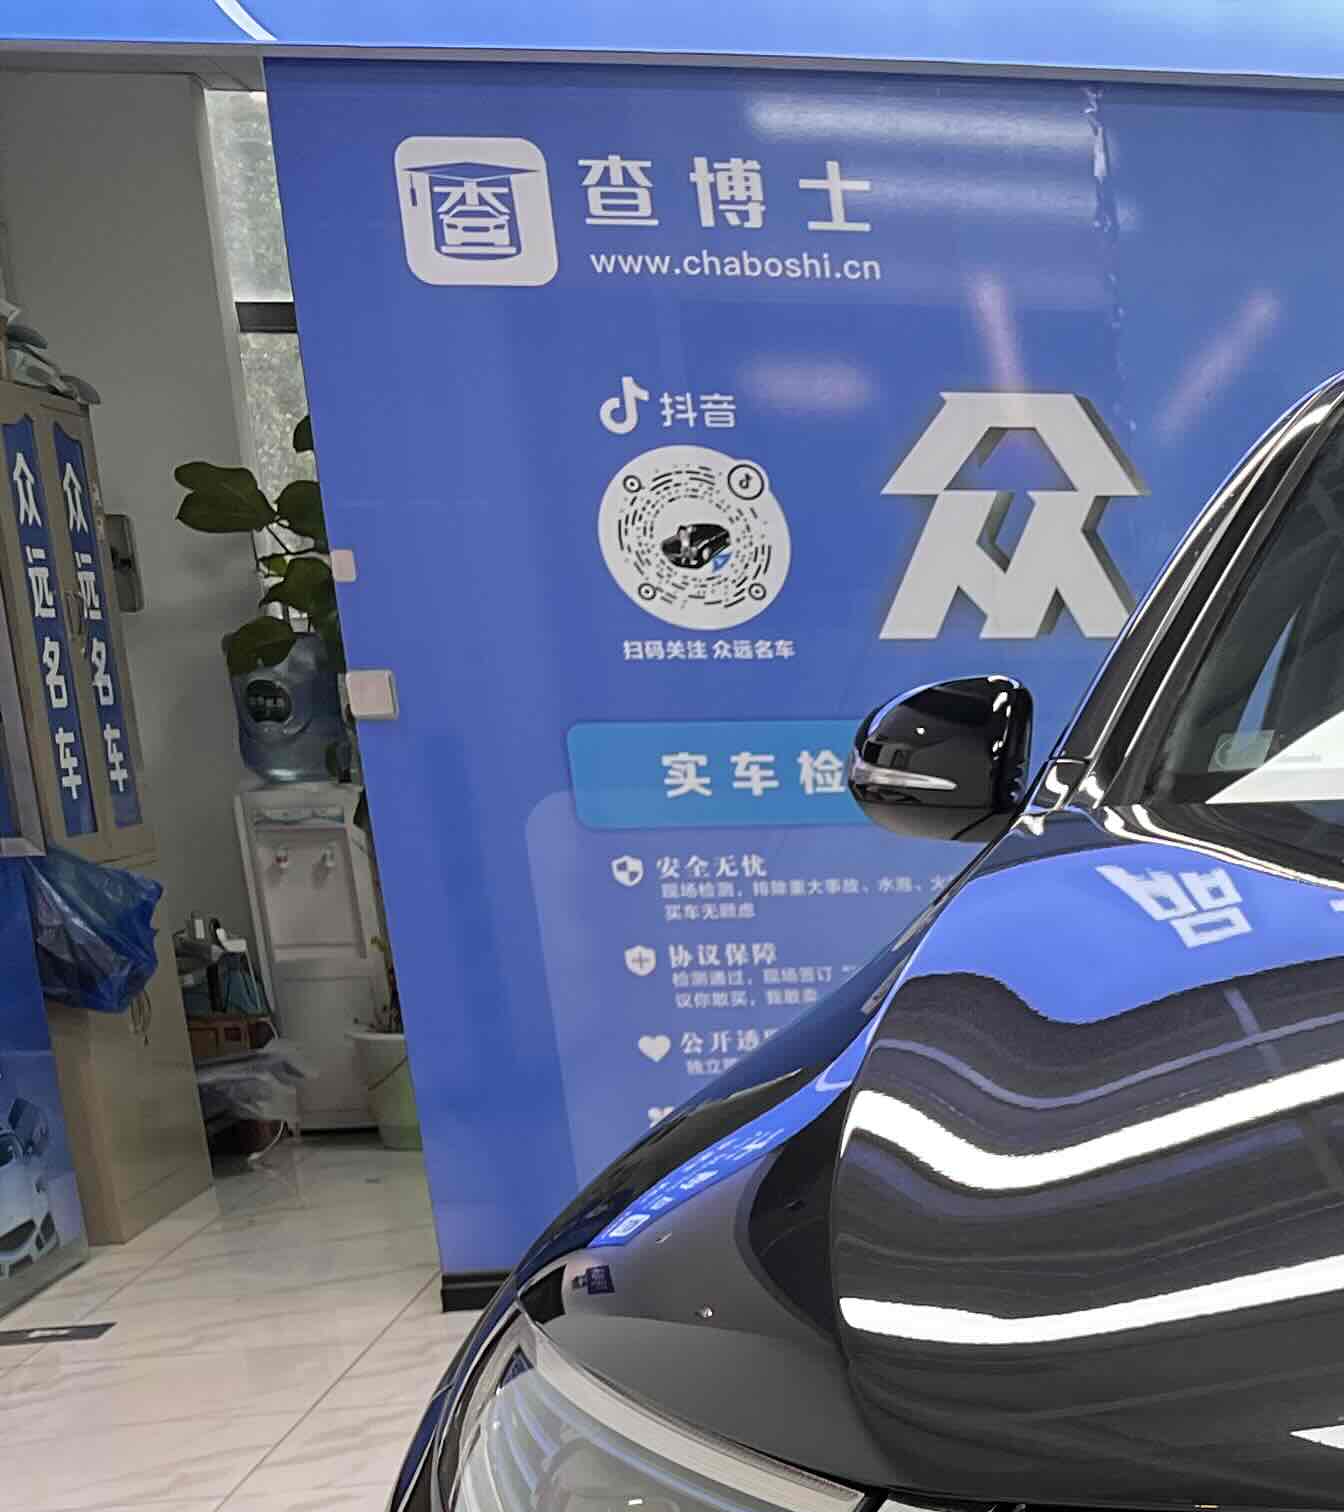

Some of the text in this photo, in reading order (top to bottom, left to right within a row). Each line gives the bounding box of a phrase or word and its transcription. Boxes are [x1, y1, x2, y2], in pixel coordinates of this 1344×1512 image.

[577, 155, 871, 232] 查博士
[590, 250, 881, 281] www.chaboshi.cn
[659, 391, 737, 428] 抖音
[623, 640, 796, 661] 扫码关注 众远名车
[656, 853, 767, 879] 安全无忧
[668, 942, 777, 969] 协议保障
